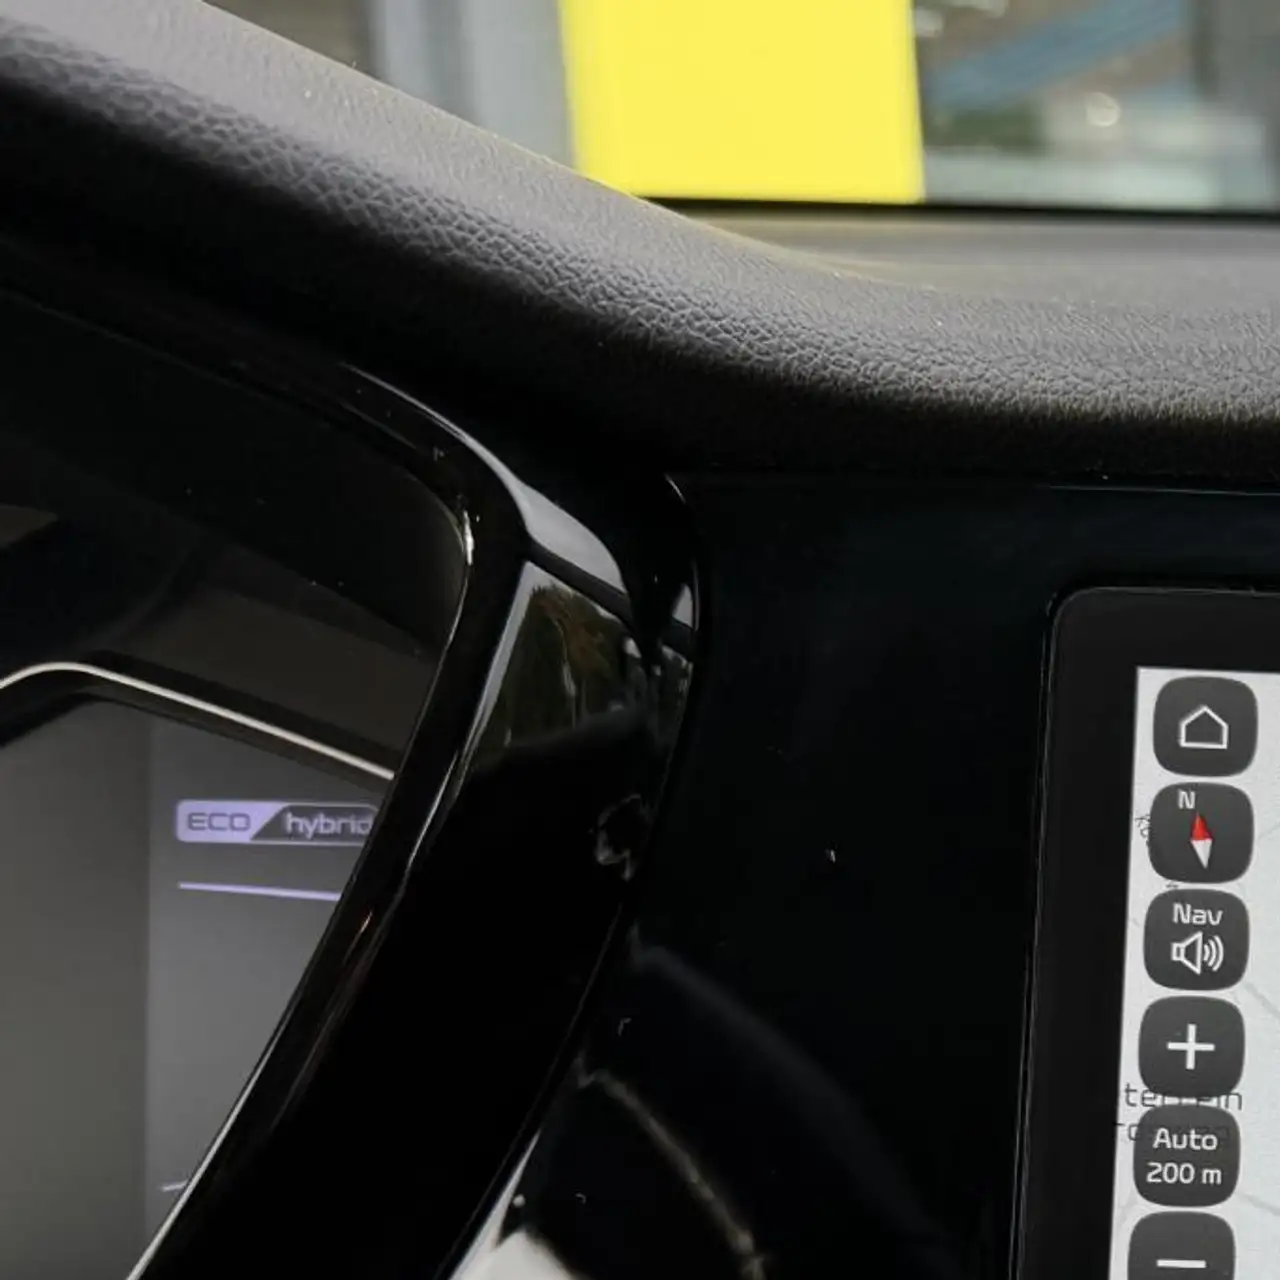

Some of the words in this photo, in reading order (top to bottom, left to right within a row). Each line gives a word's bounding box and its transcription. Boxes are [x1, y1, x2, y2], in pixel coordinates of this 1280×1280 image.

[1178, 789, 1196, 810] N
[187, 812, 251, 833] ECO
[1172, 903, 1223, 926] Nav
[1153, 1127, 1218, 1150] Auto
[1146, 1161, 1195, 1184] 200
[1201, 1167, 1222, 1185] m
